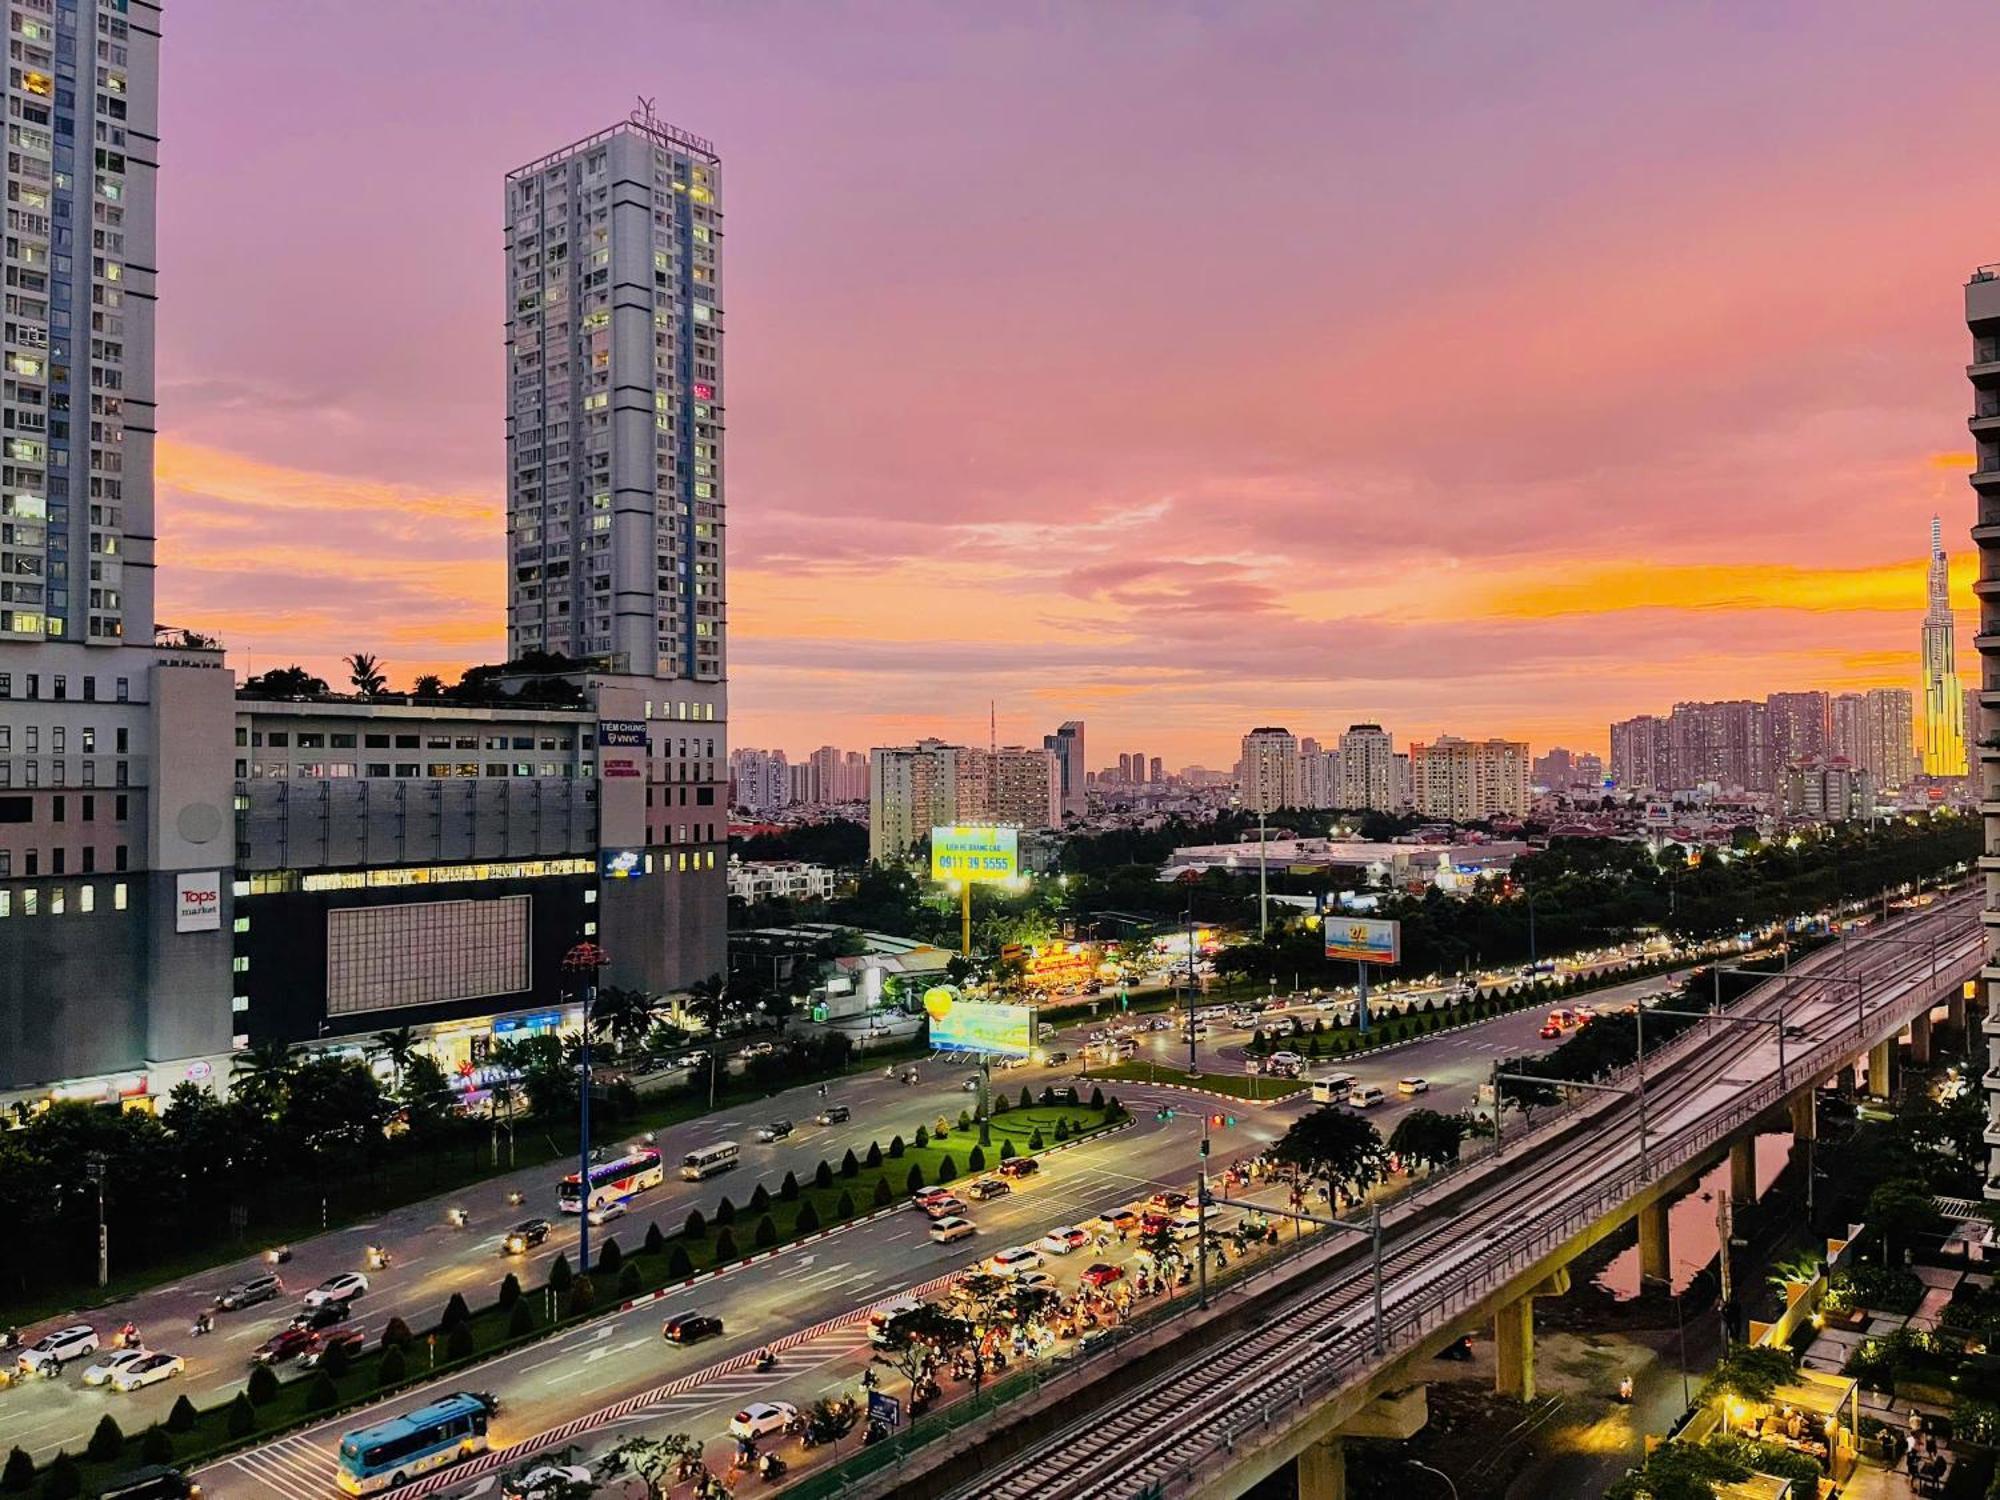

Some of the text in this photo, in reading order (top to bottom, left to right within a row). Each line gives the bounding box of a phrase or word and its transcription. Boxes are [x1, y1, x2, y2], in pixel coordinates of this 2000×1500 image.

[939, 855, 1008, 870] 0911 39 5555
[181, 890, 217, 905] Tops
[181, 906, 217, 916] market
